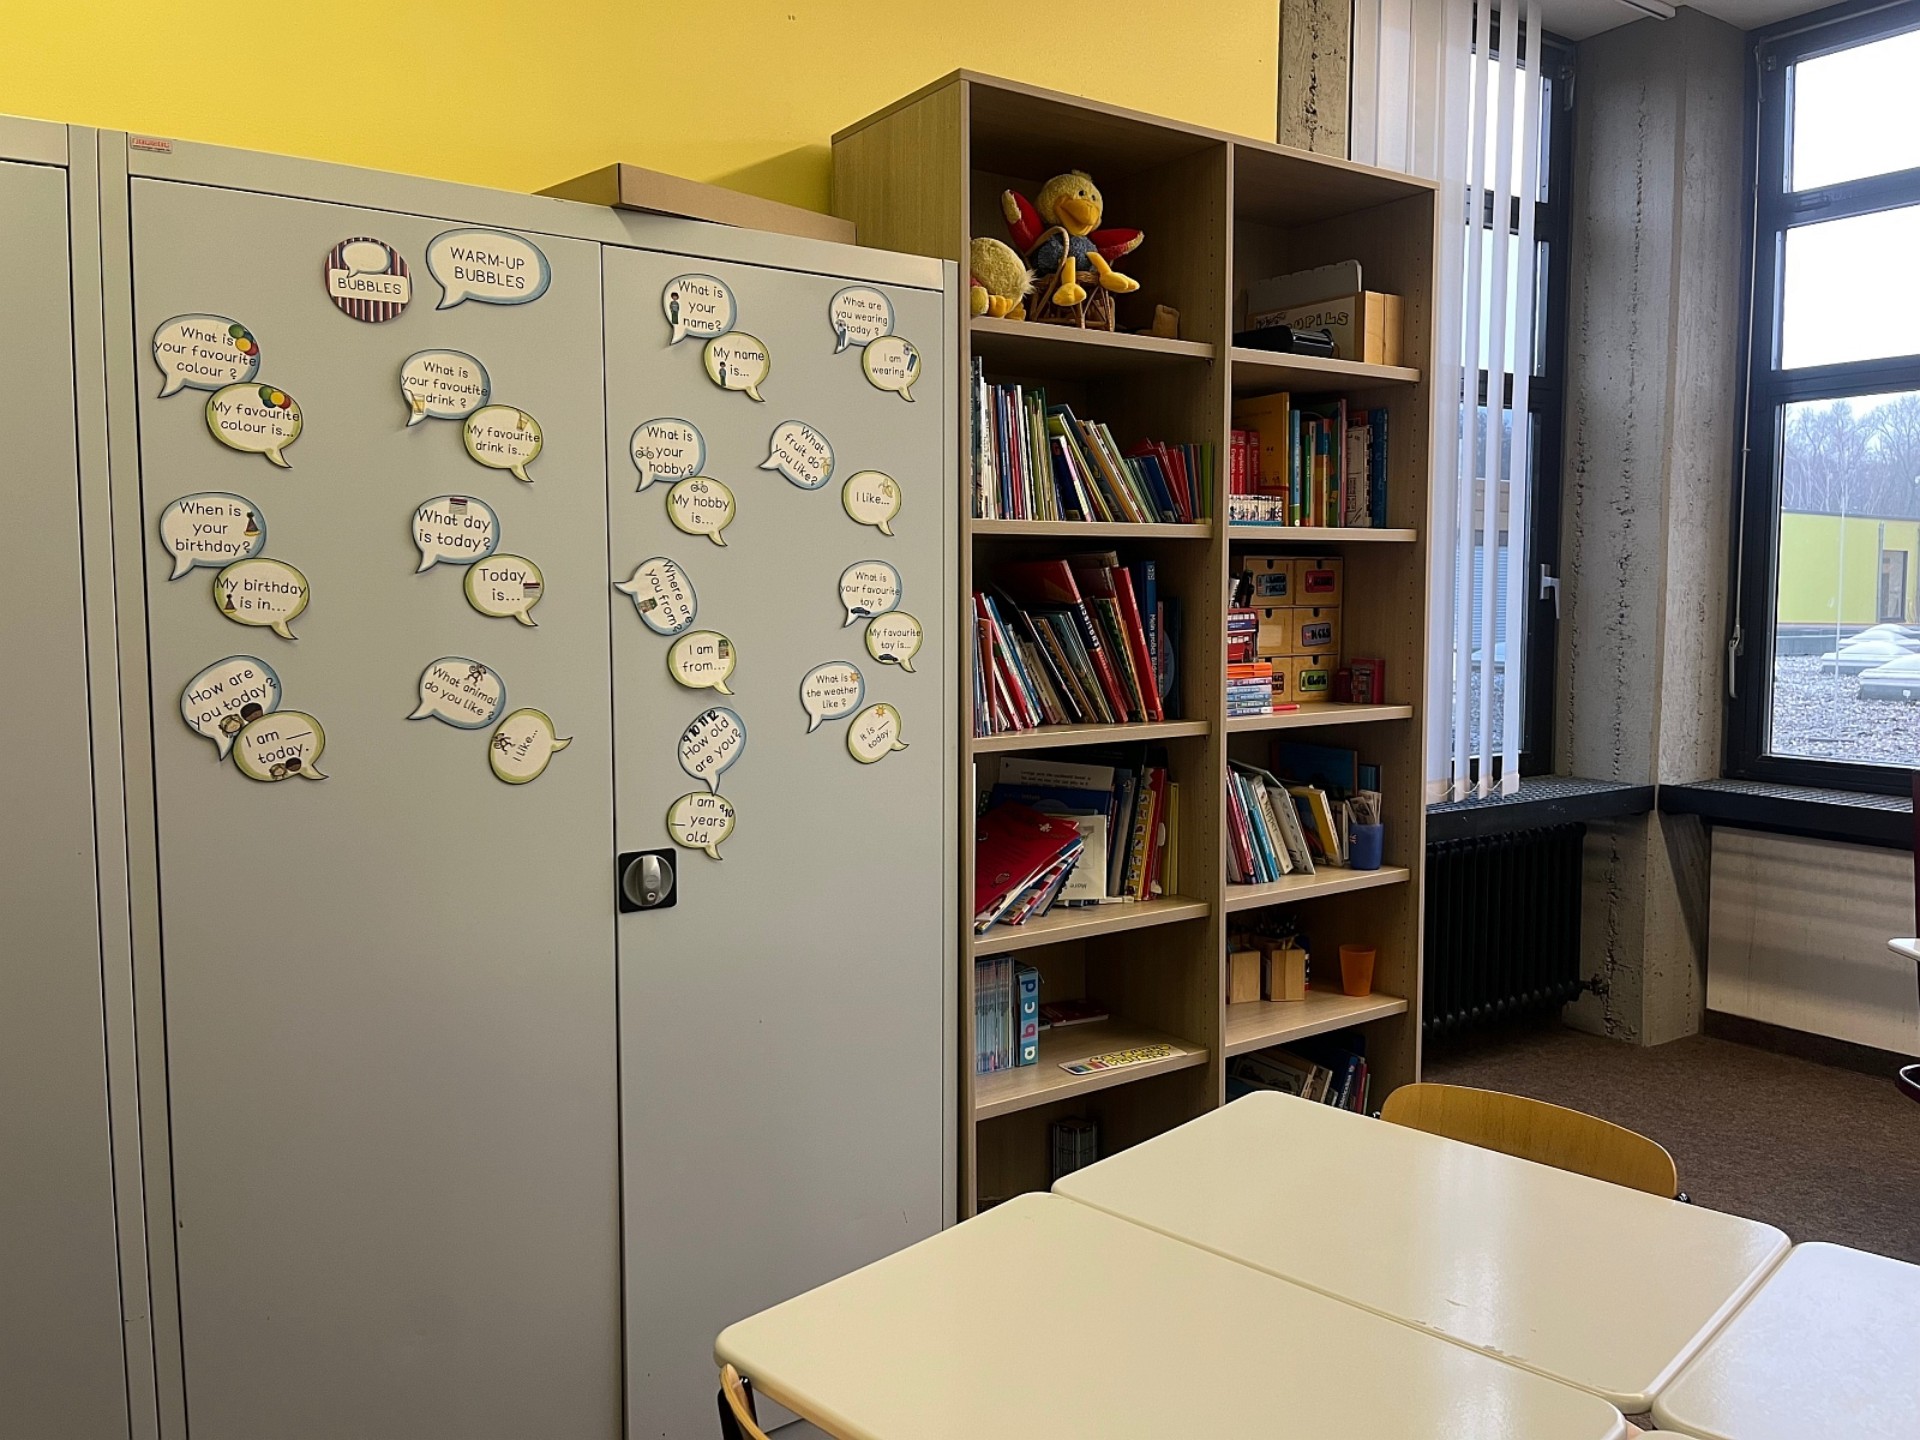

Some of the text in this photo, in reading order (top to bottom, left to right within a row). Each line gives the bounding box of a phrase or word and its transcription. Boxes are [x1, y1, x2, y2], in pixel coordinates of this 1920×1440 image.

[450, 246, 525, 270] WARM-UP
[455, 266, 525, 289] BUBBLES
[338, 278, 402, 295] BUBBLES
[678, 279, 723, 299] What is
[688, 301, 716, 314] your
[842, 295, 882, 311] What are
[683, 317, 722, 332] name?
[835, 310, 888, 326] you wearing
[180, 325, 234, 346] What is
[846, 324, 871, 337] today
[154, 341, 256, 367] your favourite
[713, 346, 765, 362] My name
[889, 354, 902, 363] am
[176, 361, 224, 377] colour
[423, 360, 469, 379] What is
[872, 366, 905, 379] wearing
[401, 375, 429, 386] your
[425, 393, 455, 407] drink
[211, 400, 300, 422] My favourite
[220, 419, 267, 434] colour
[467, 424, 540, 443] My favourite
[647, 425, 693, 442] What is
[476, 441, 504, 453] drink
[801, 426, 825, 454] What
[655, 447, 684, 459] your
[785, 433, 819, 469] fruit do
[648, 461, 694, 477] hobby?
[772, 443, 818, 486] you like?
[179, 501, 242, 517] When is
[672, 493, 730, 512] My hobby
[418, 508, 491, 534] What day
[192, 523, 229, 537] your
[175, 538, 251, 556] birthday?
[419, 529, 491, 552] is today?
[478, 568, 526, 585] Today
[645, 568, 664, 593] you
[855, 571, 887, 582] What is
[216, 577, 307, 598] My birthday
[663, 559, 693, 623] Where are
[840, 584, 900, 596] your favourite
[239, 596, 252, 609] is
[869, 628, 921, 639] My favourite
[696, 645, 713, 655] am
[188, 669, 254, 705] How are
[432, 666, 498, 706] What animal
[815, 673, 848, 684] What is
[425, 681, 439, 693] do
[440, 689, 463, 705] you
[463, 699, 485, 716] like
[806, 686, 858, 698] the weather
[189, 677, 277, 731] you today?
[682, 734, 692, 744] 9
[688, 724, 701, 736] 10
[706, 709, 720, 722] 12
[865, 726, 876, 736] is
[245, 731, 280, 748] I am
[682, 716, 730, 760] How old
[258, 743, 309, 764] today.
[695, 727, 742, 773] are you?
[697, 798, 715, 808] am
[690, 815, 726, 828] years
[685, 831, 710, 844] old.
